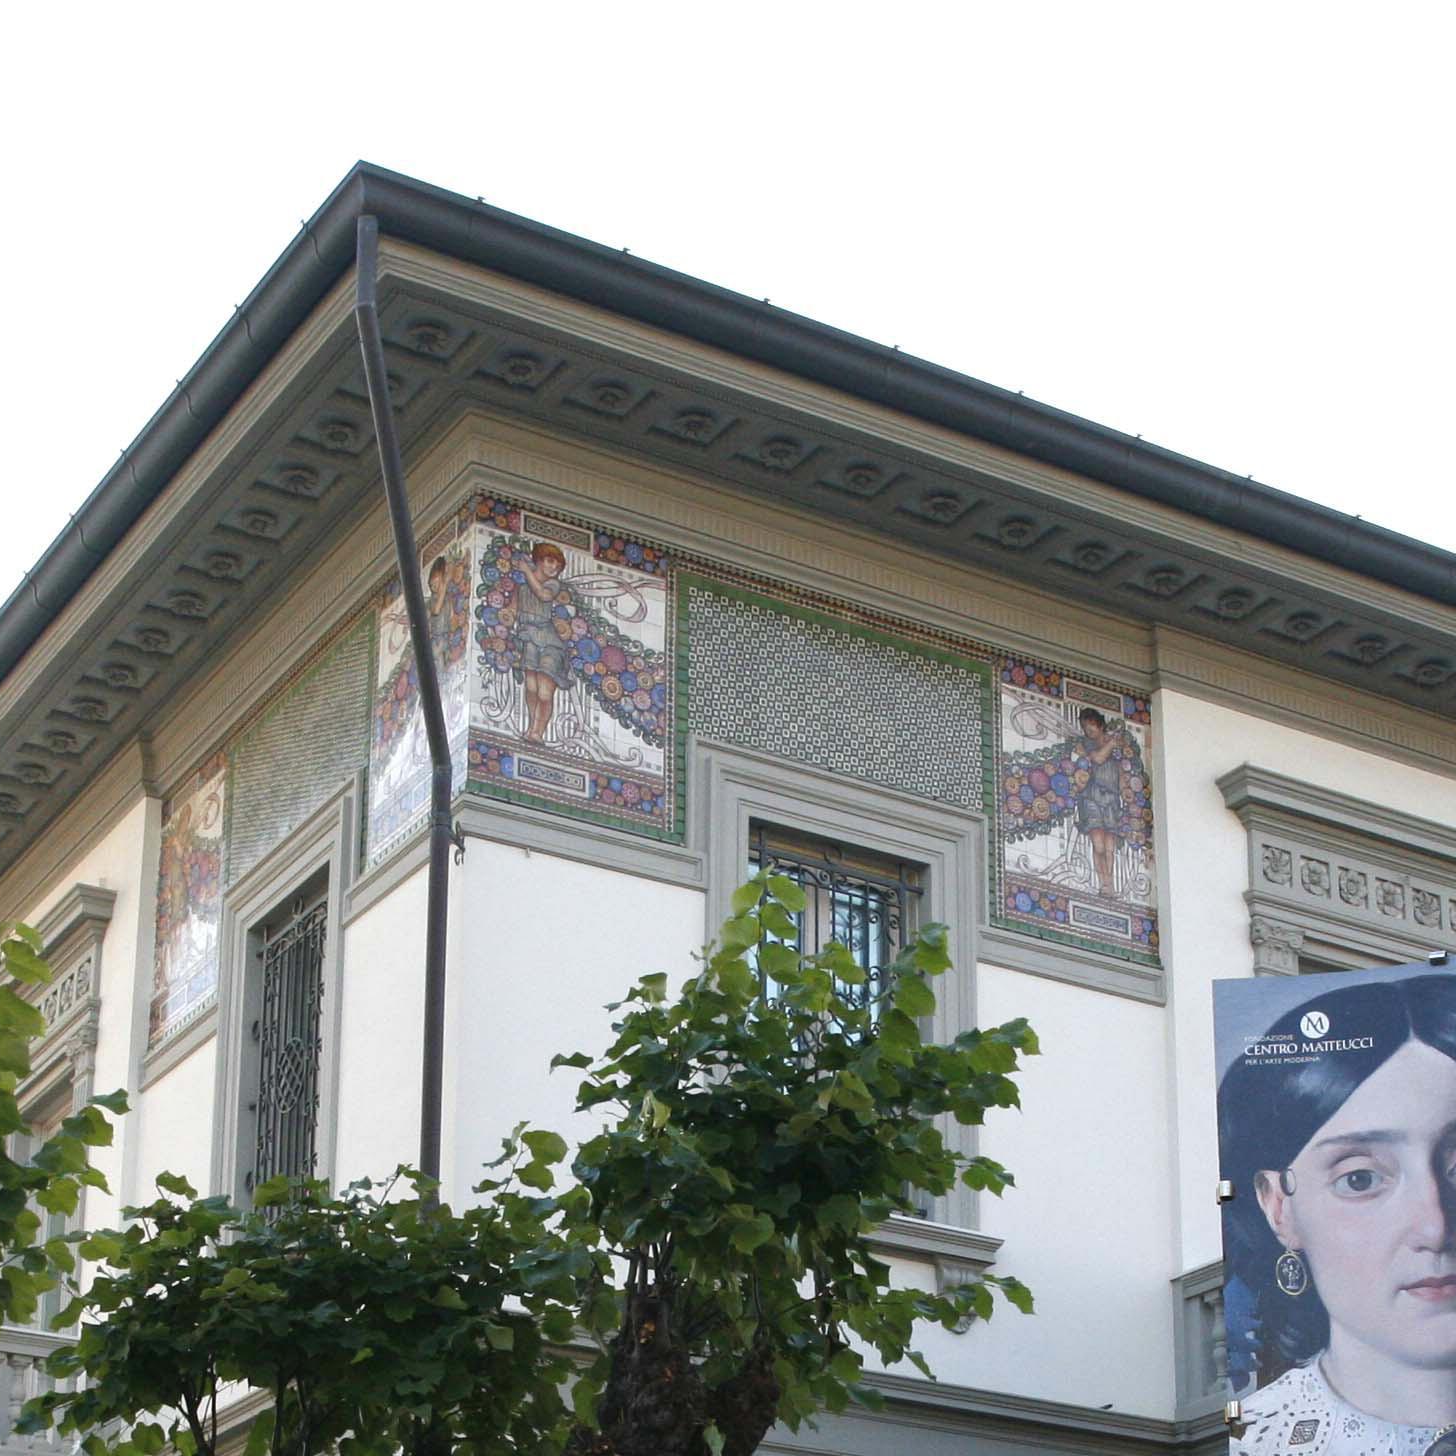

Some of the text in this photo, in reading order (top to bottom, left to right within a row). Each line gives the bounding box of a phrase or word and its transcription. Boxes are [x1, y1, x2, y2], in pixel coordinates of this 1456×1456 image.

[1244, 1037, 1374, 1056] CENTRO MATTEUCCI
[1245, 1058, 1258, 1066] PER
